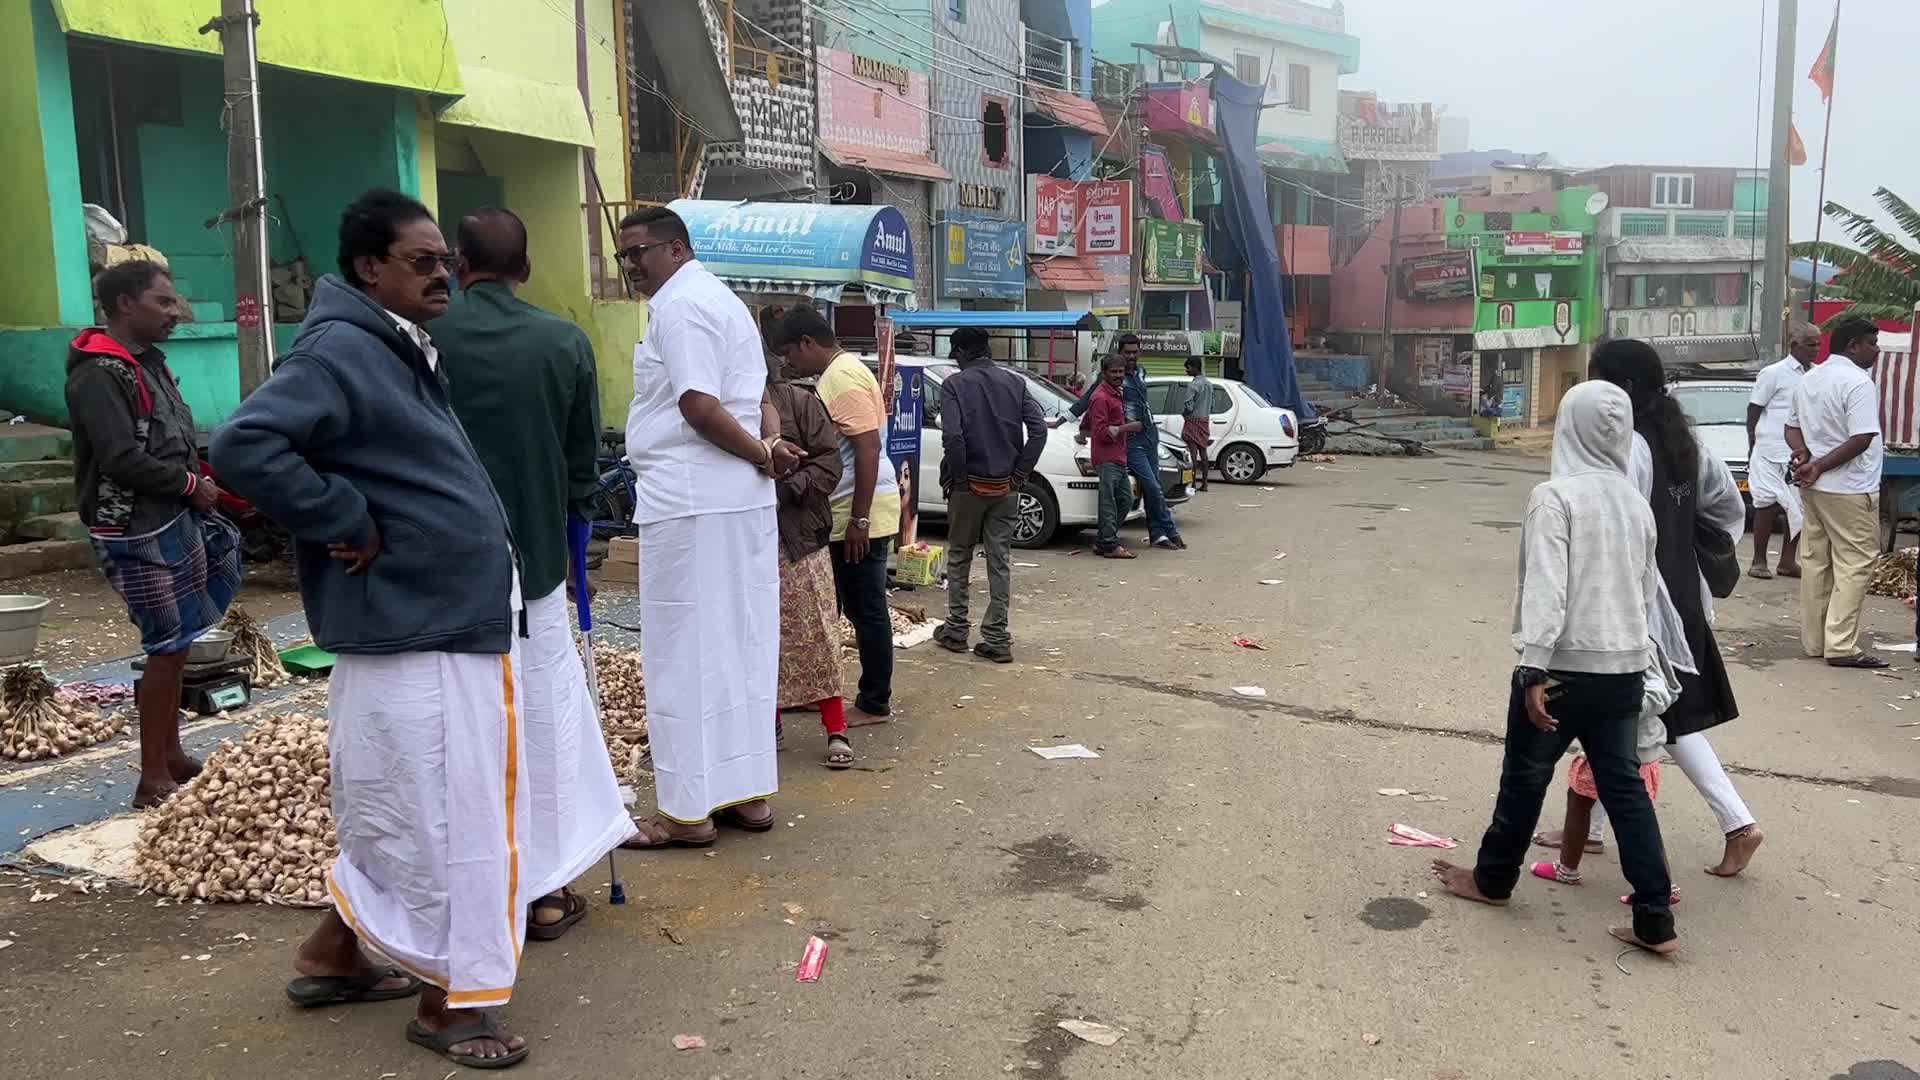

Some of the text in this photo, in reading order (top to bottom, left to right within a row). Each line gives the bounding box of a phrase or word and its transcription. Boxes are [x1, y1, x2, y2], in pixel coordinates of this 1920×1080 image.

[704, 208, 816, 236] Amul
[693, 241, 714, 250] Real
[742, 243, 764, 253] Real
[873, 220, 906, 255] Amul
[1439, 267, 1467, 277] ATM
[892, 398, 916, 435] Amul
